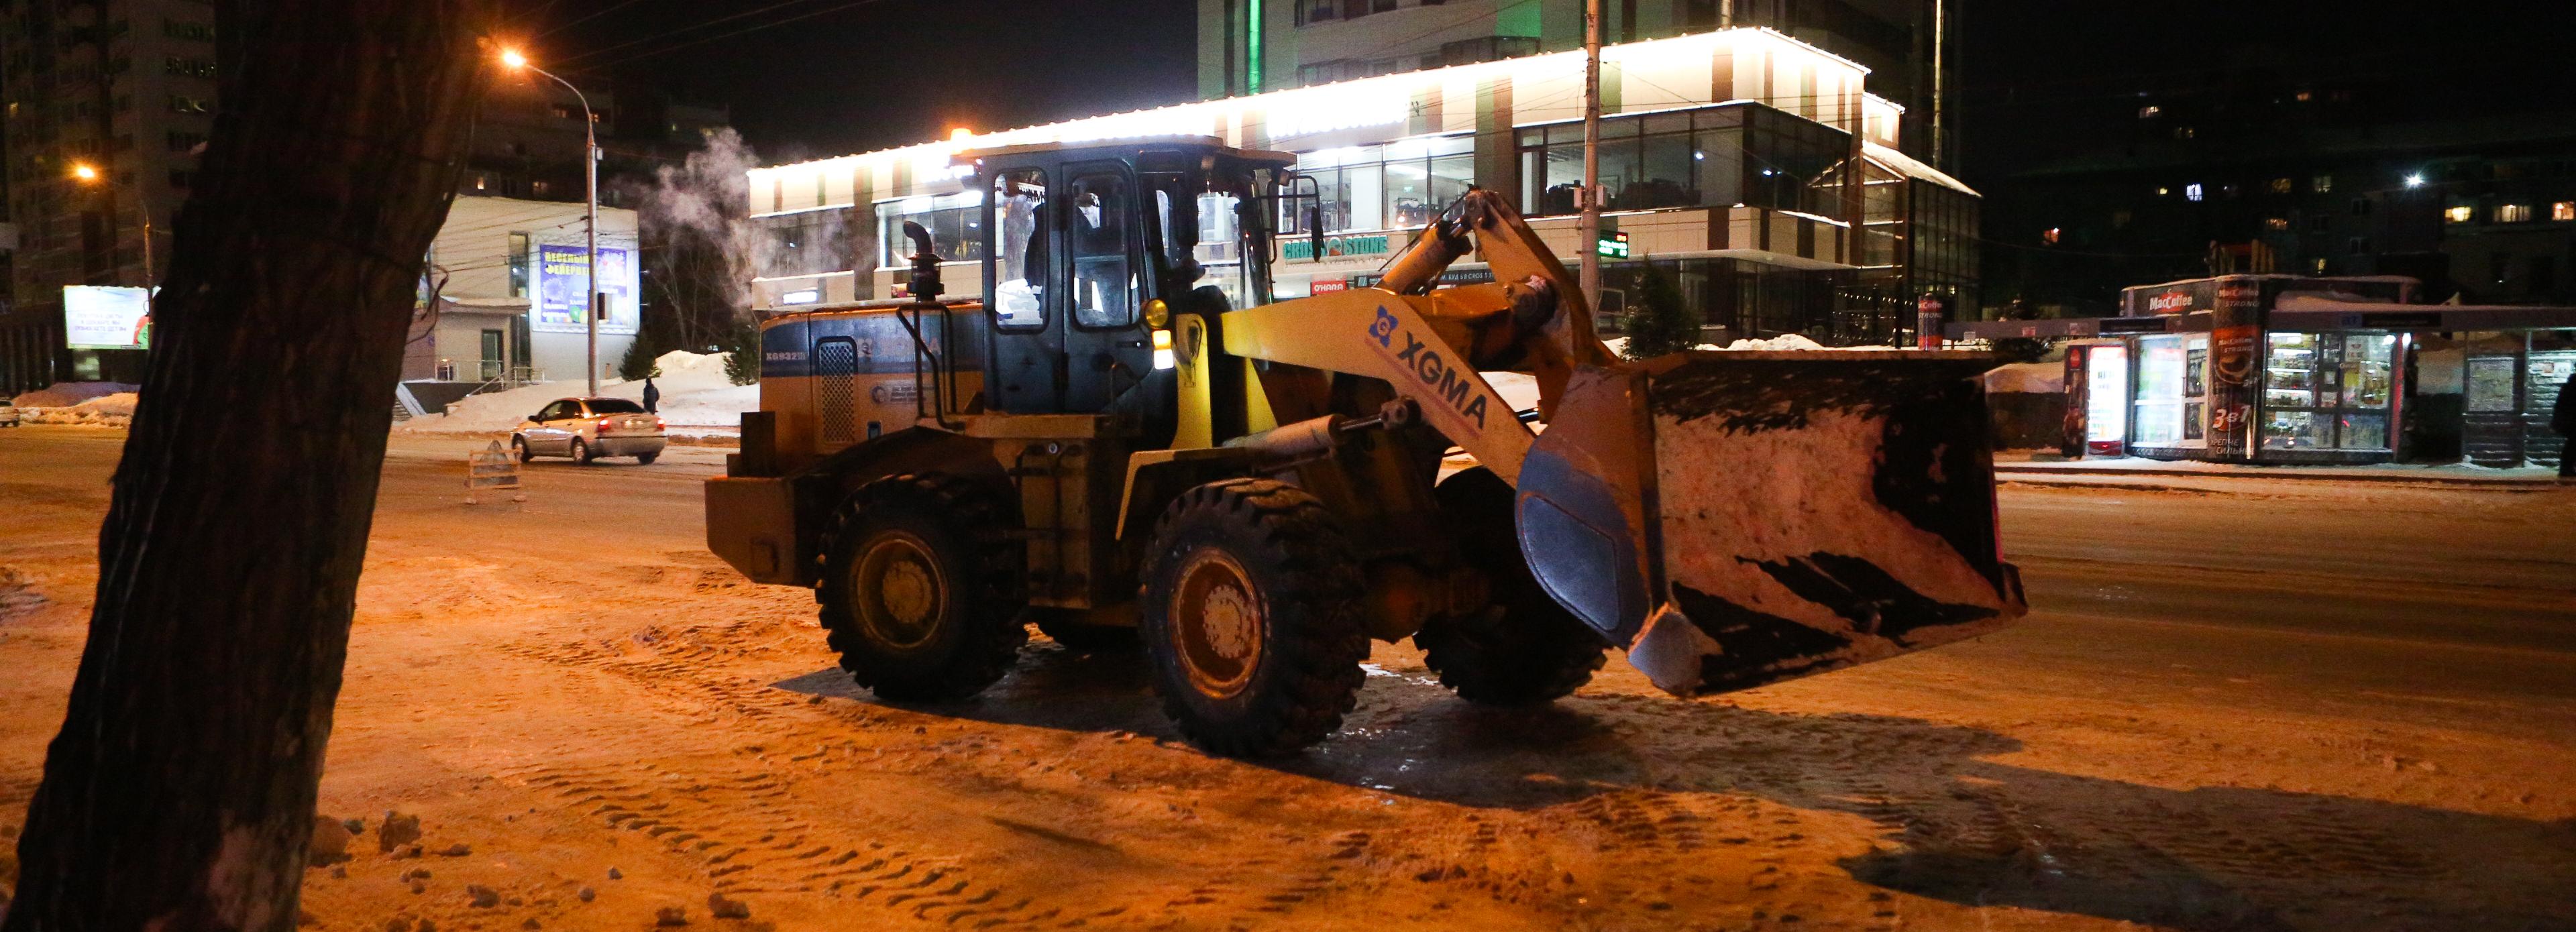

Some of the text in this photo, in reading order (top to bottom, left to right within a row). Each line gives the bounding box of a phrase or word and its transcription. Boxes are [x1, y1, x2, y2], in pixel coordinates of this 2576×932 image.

[1344, 235, 1389, 255] STONE
[545, 264, 590, 275] ФЕЙЕРВЕ
[1314, 284, 1344, 292] O'HANA
[2149, 294, 2192, 310] MacCoffee
[1397, 331, 1487, 430] XGMA
[2216, 447, 2253, 455] СИЛЬН
